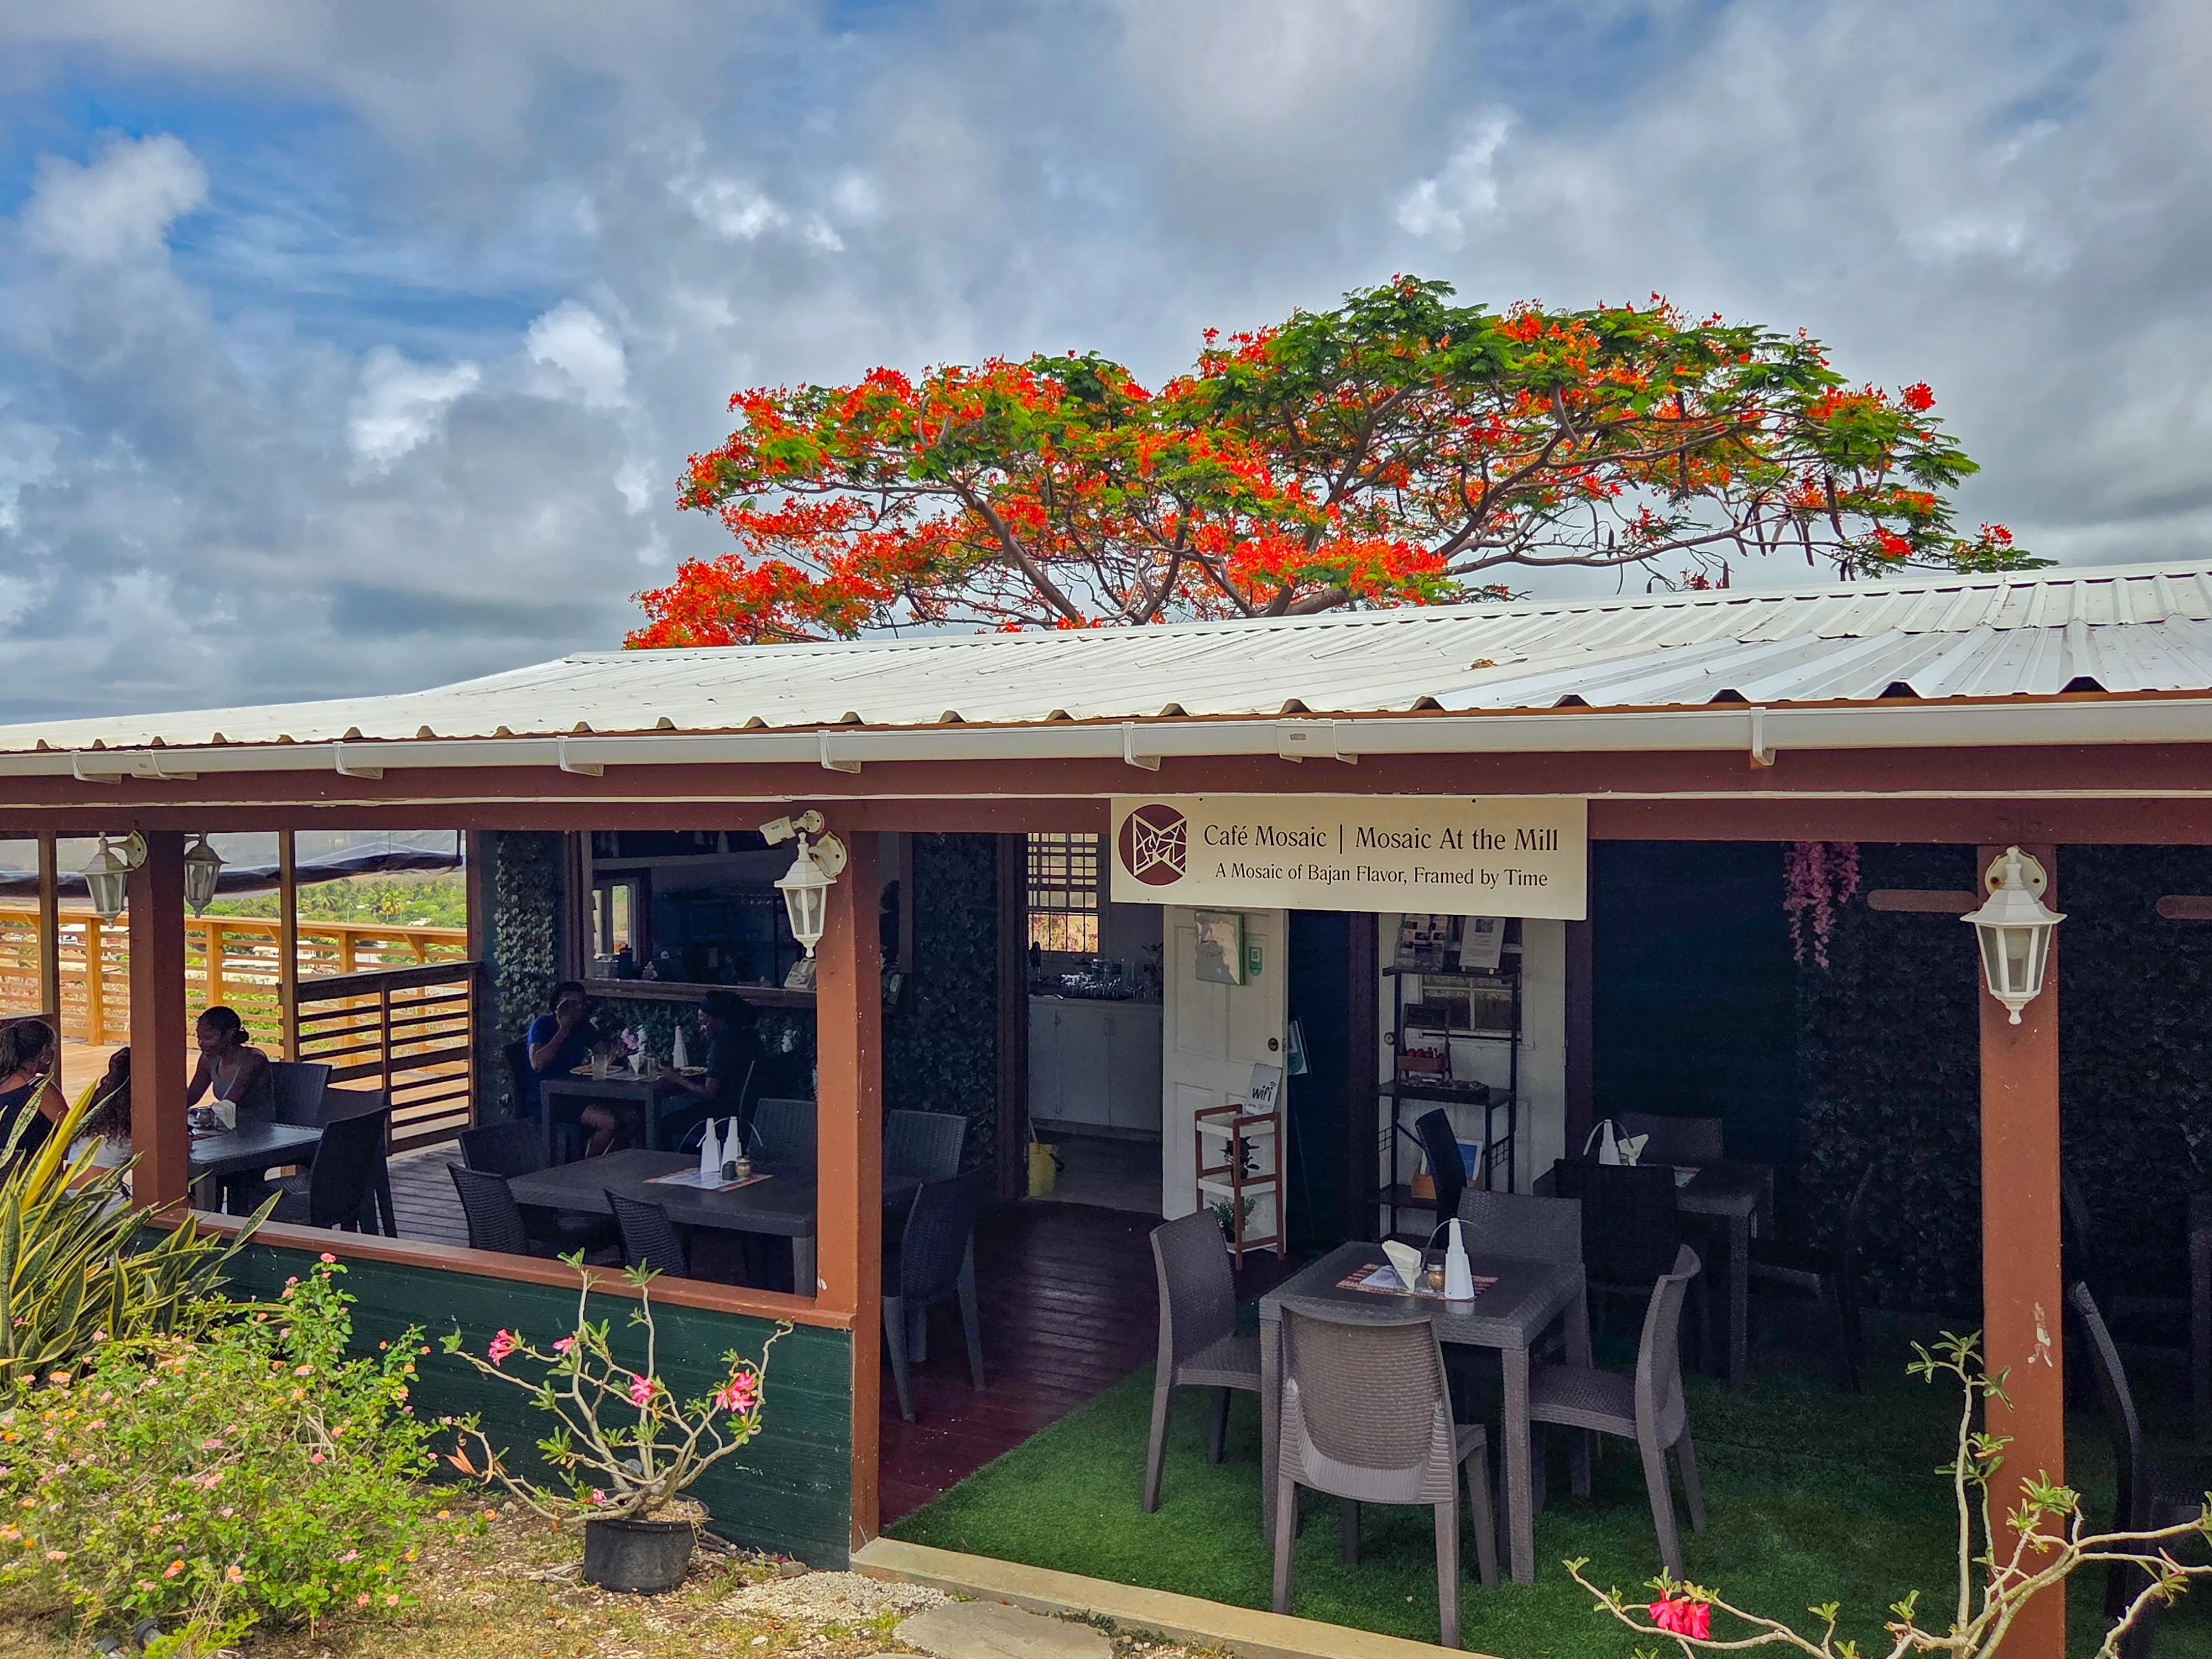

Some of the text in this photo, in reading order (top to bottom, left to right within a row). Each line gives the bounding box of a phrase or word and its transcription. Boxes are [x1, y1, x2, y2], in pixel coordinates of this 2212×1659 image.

[1203, 824, 1248, 847] Café
[1255, 825, 1327, 847] Mosaic
[1355, 826, 1432, 849] Mosaic
[1439, 828, 1464, 851] At
[1472, 828, 1506, 851] the
[1514, 828, 1558, 852] Mill
[1215, 863, 1548, 889] A Mosaic of Bajan Flavor, Framed by Time
[1253, 1085, 1273, 1102] wifi
